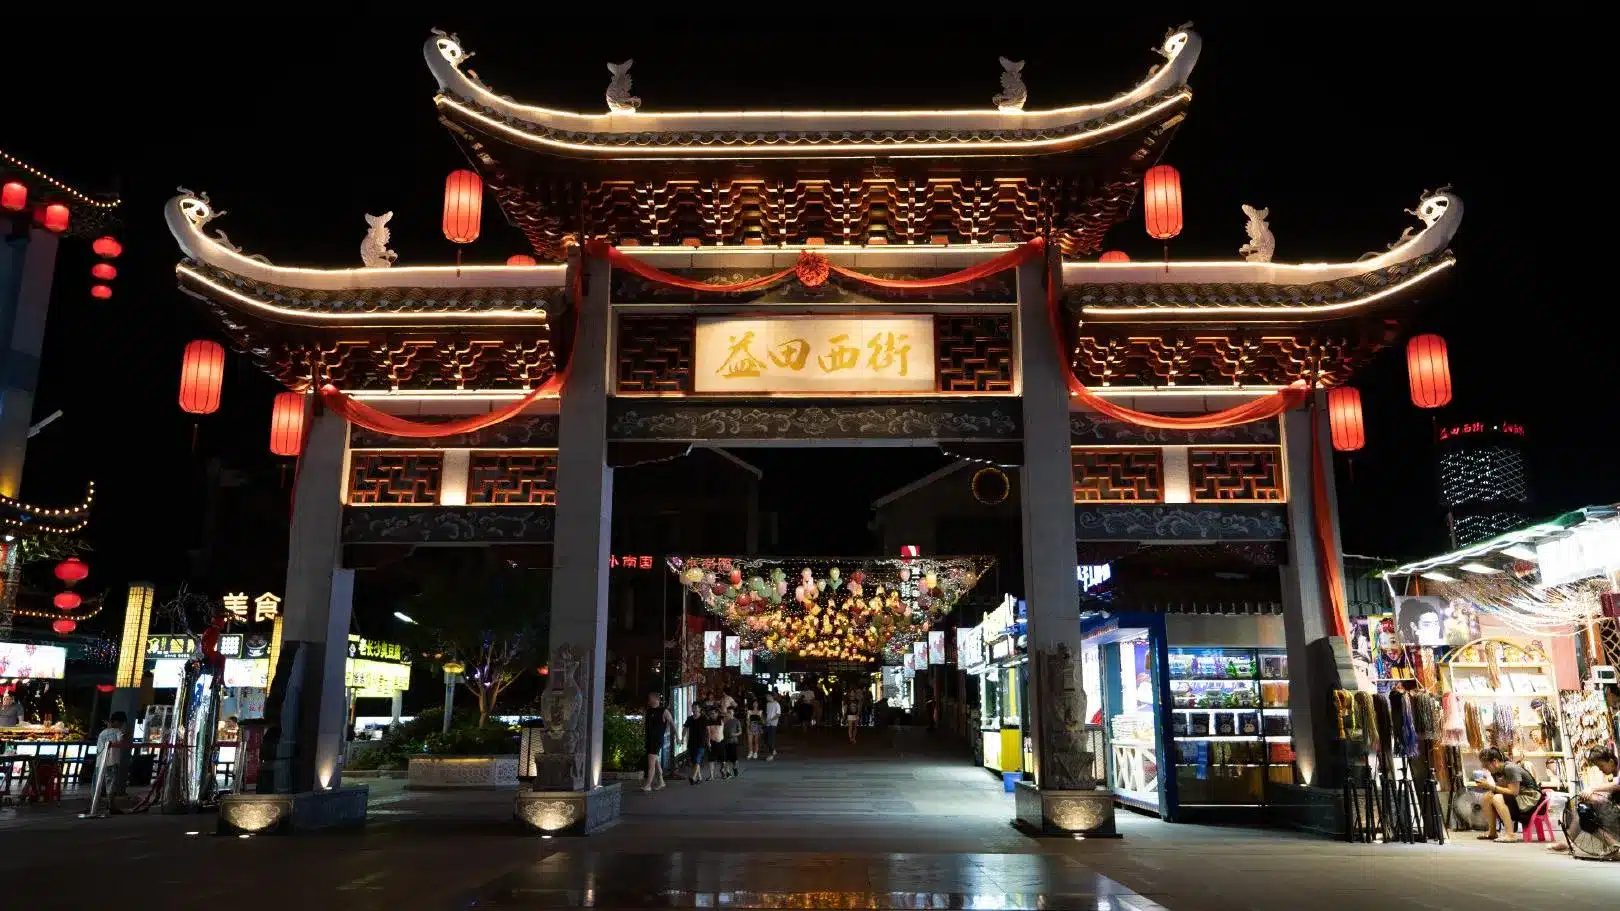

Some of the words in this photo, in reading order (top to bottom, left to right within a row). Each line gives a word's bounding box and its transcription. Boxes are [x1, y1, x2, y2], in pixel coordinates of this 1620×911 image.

[716, 331, 911, 379] 益田西街
[223, 591, 282, 623] 美食
